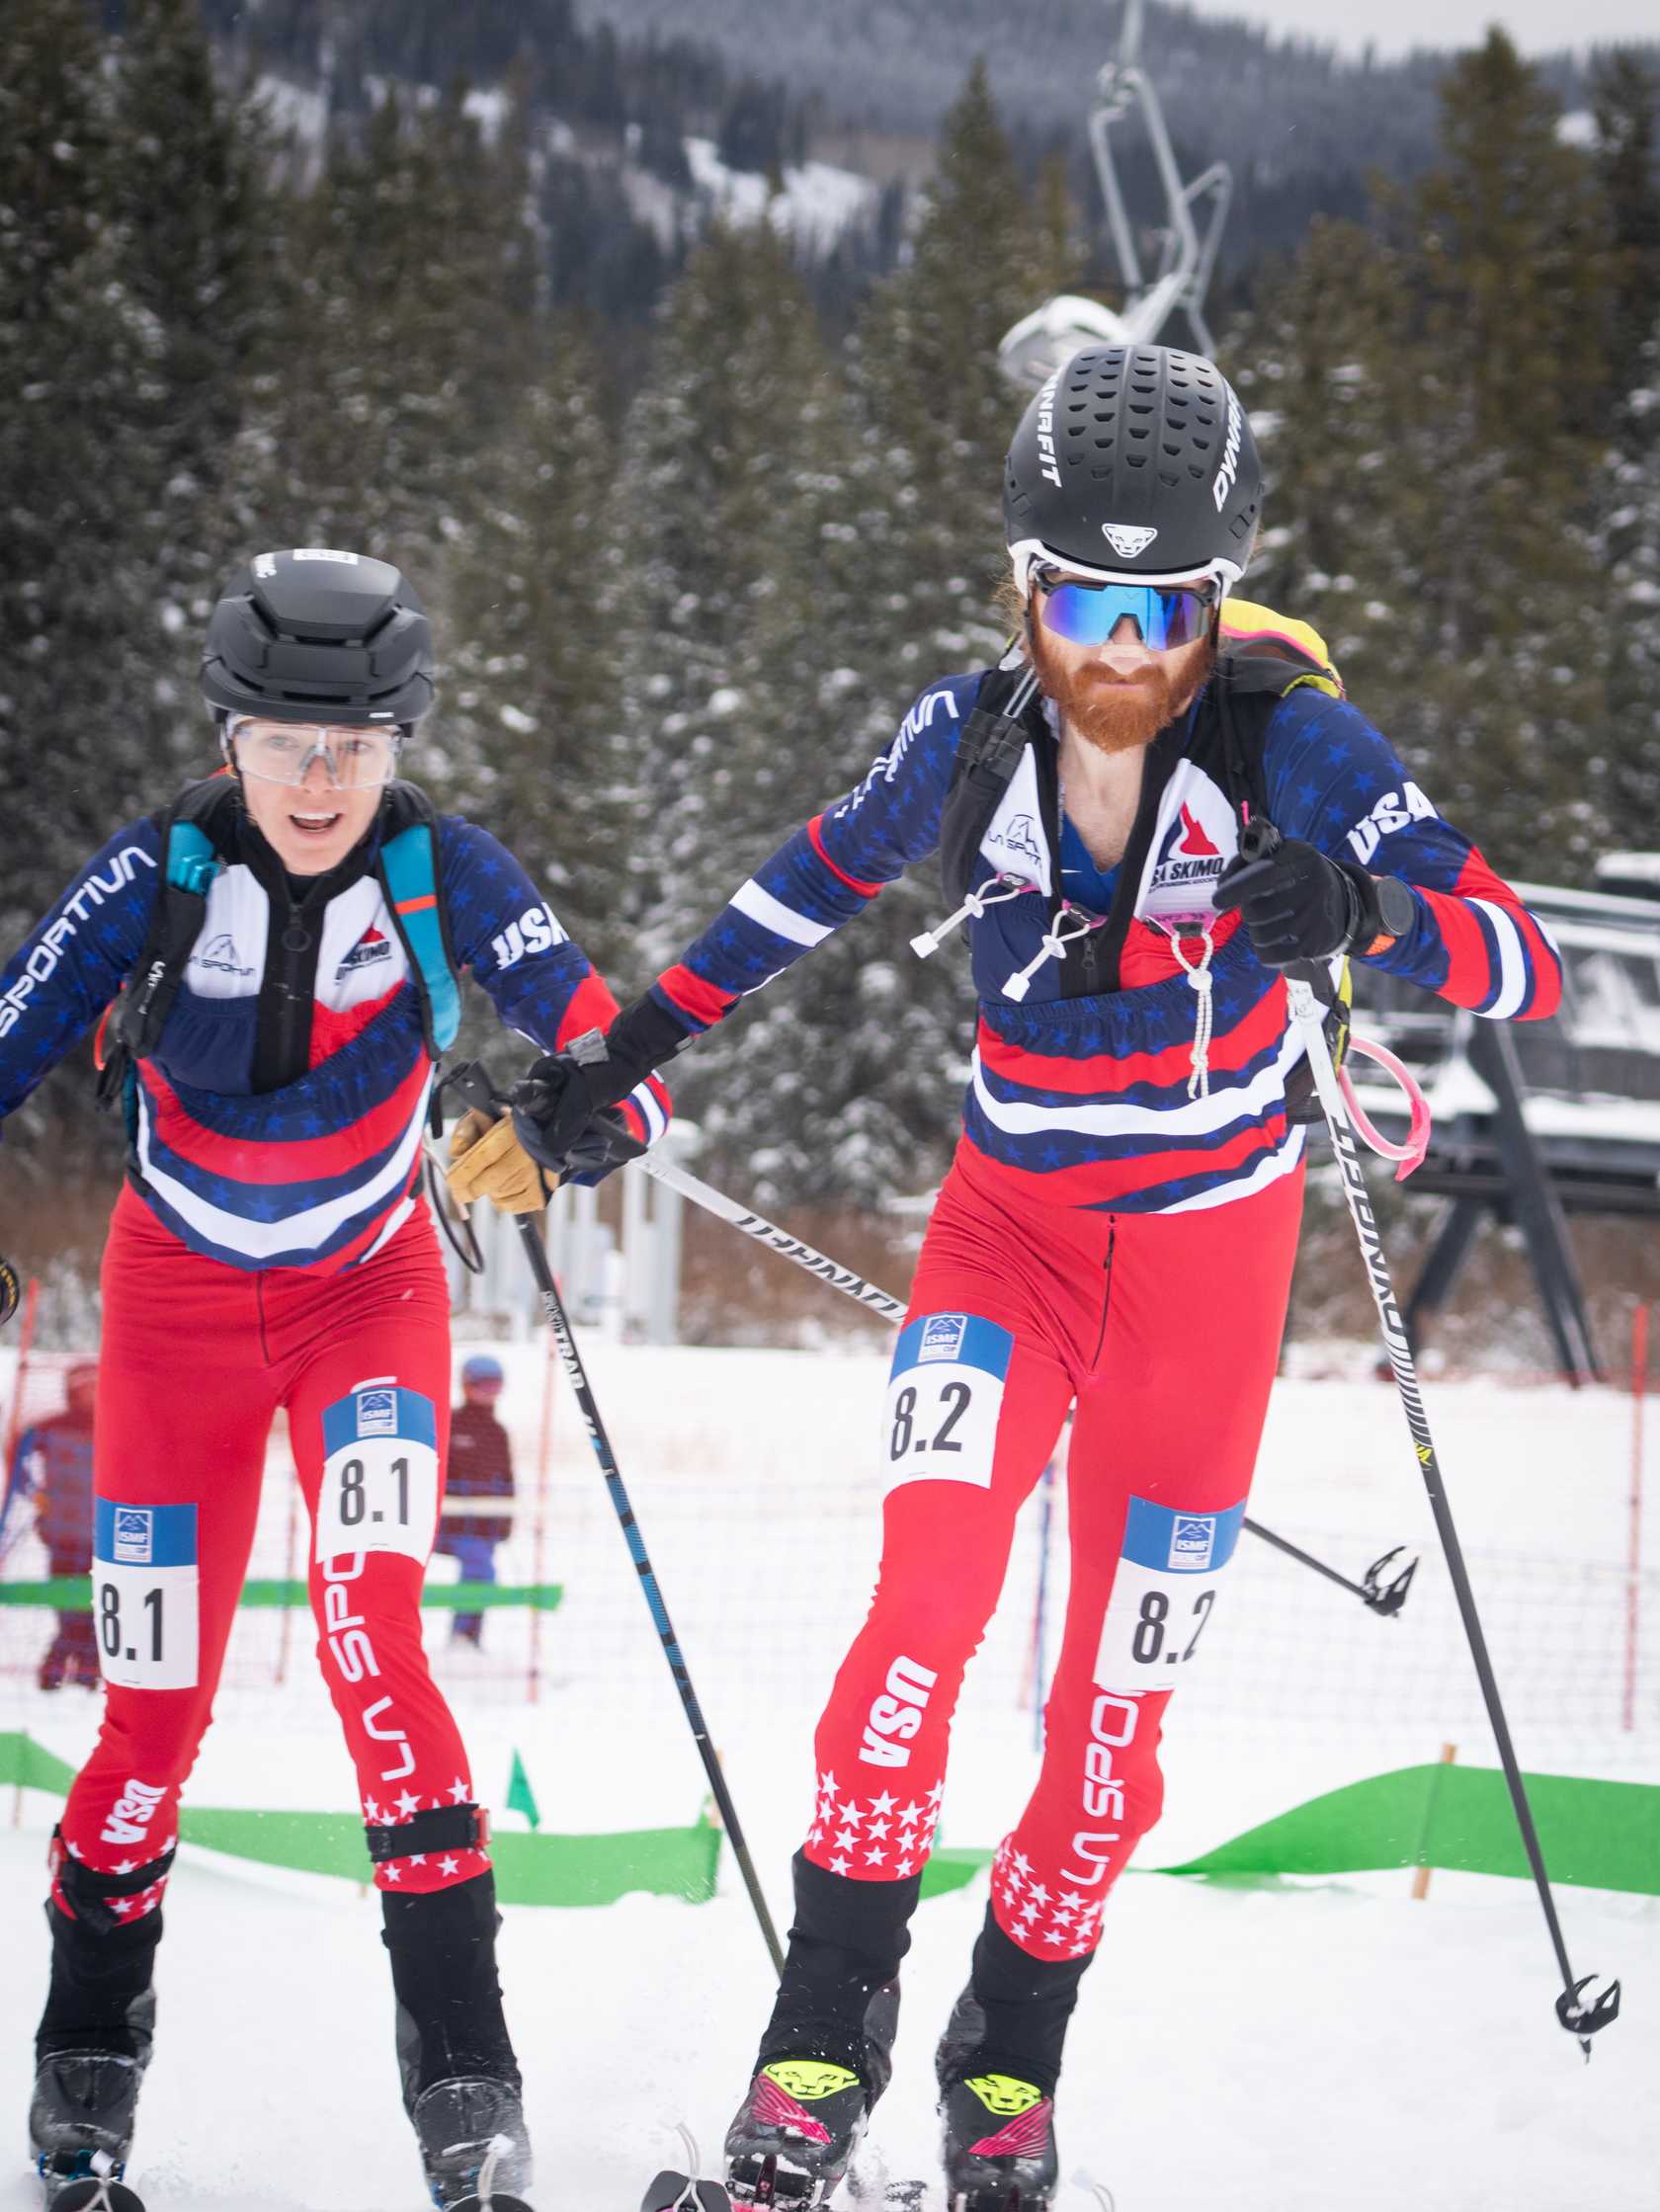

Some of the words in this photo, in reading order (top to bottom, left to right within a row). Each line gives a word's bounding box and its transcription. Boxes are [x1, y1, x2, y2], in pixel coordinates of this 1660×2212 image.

[1346, 780, 1440, 865] USA
[1170, 858, 1224, 880] SKIMO
[490, 901, 570, 970] USA
[1332, 1114, 1406, 1335] DYNAFIT
[927, 1334, 958, 1346] ISMF
[890, 1381, 971, 1462] 8.2
[340, 1457, 409, 1526] 8.1
[118, 1531, 149, 1543] ISMF
[101, 1583, 163, 1662] 8.1
[1131, 1590, 1216, 1664] 8.2
[859, 1655, 939, 1768] USA
[100, 1778, 168, 1844] USA
